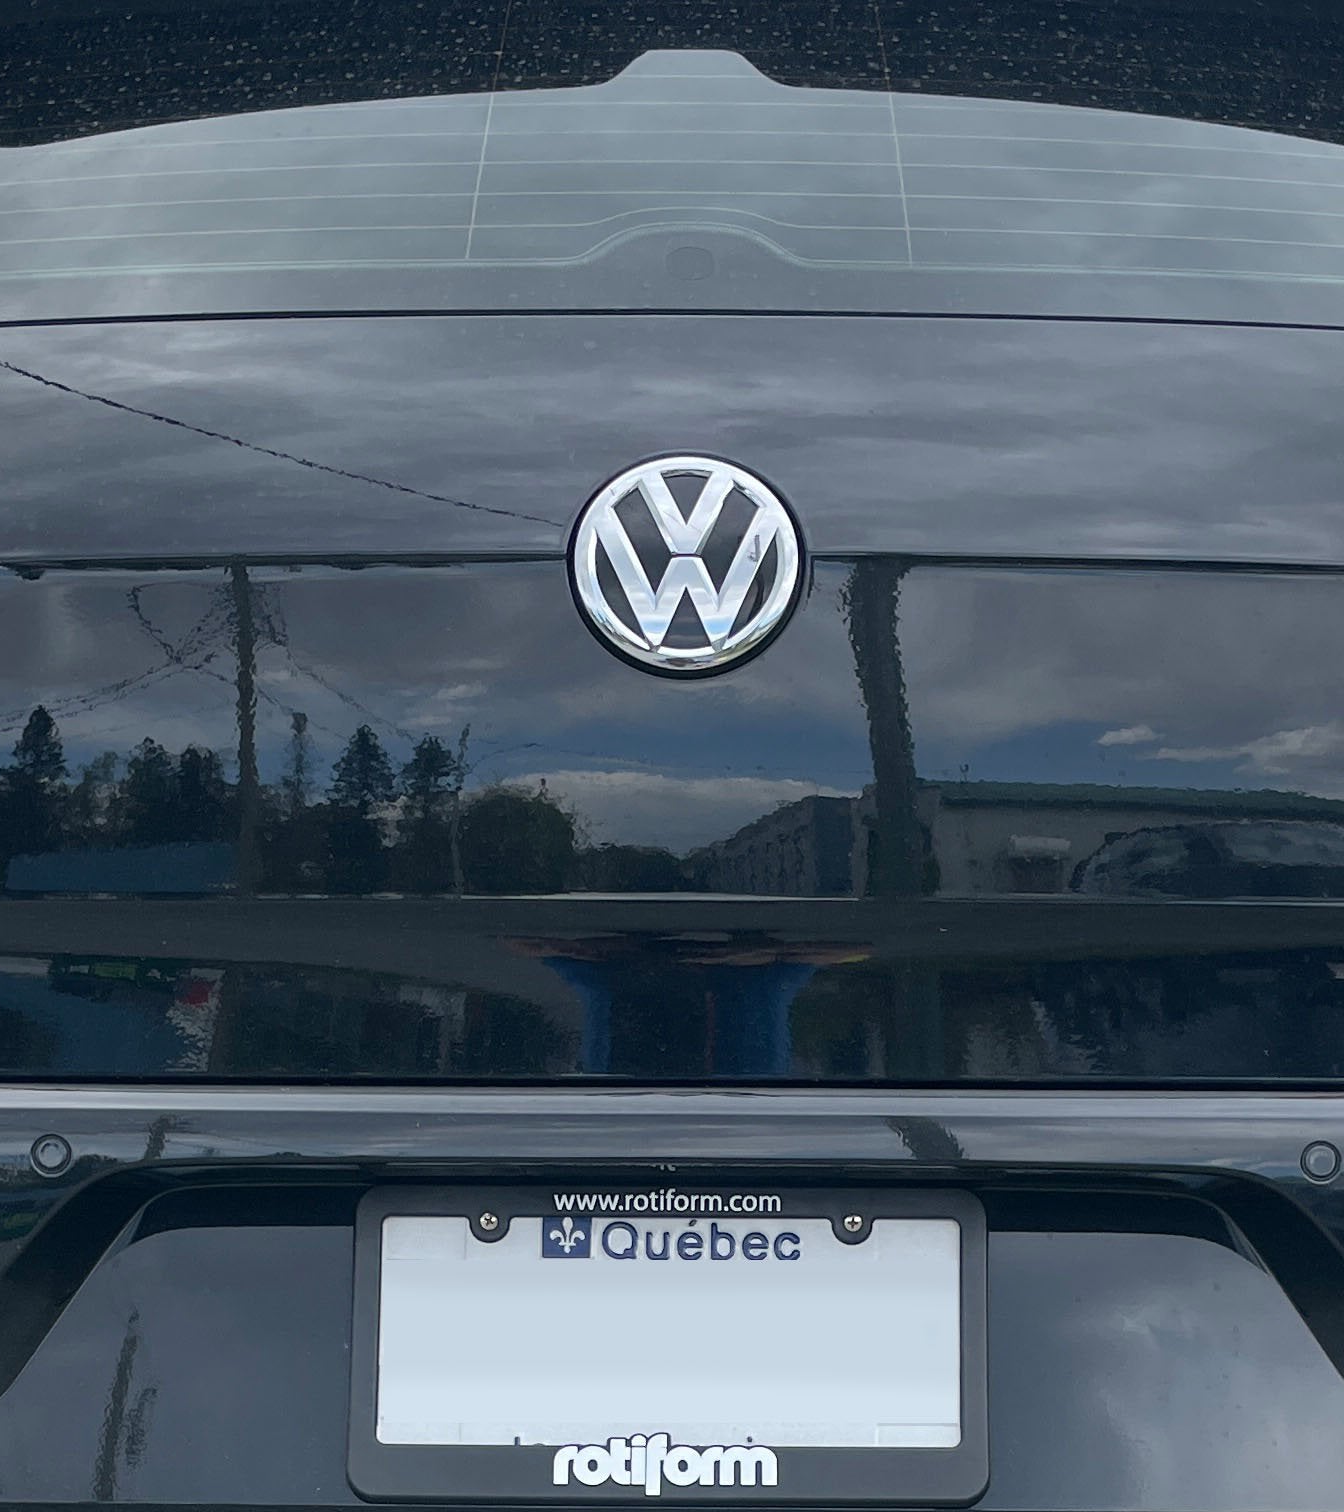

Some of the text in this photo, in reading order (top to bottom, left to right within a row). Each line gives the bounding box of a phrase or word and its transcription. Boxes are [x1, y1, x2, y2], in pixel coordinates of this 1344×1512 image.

[588, 461, 786, 656] VW
[553, 1188, 781, 1213] www.rotiform.com
[601, 1219, 801, 1261] Québec
[552, 1432, 778, 1496] rotiform
